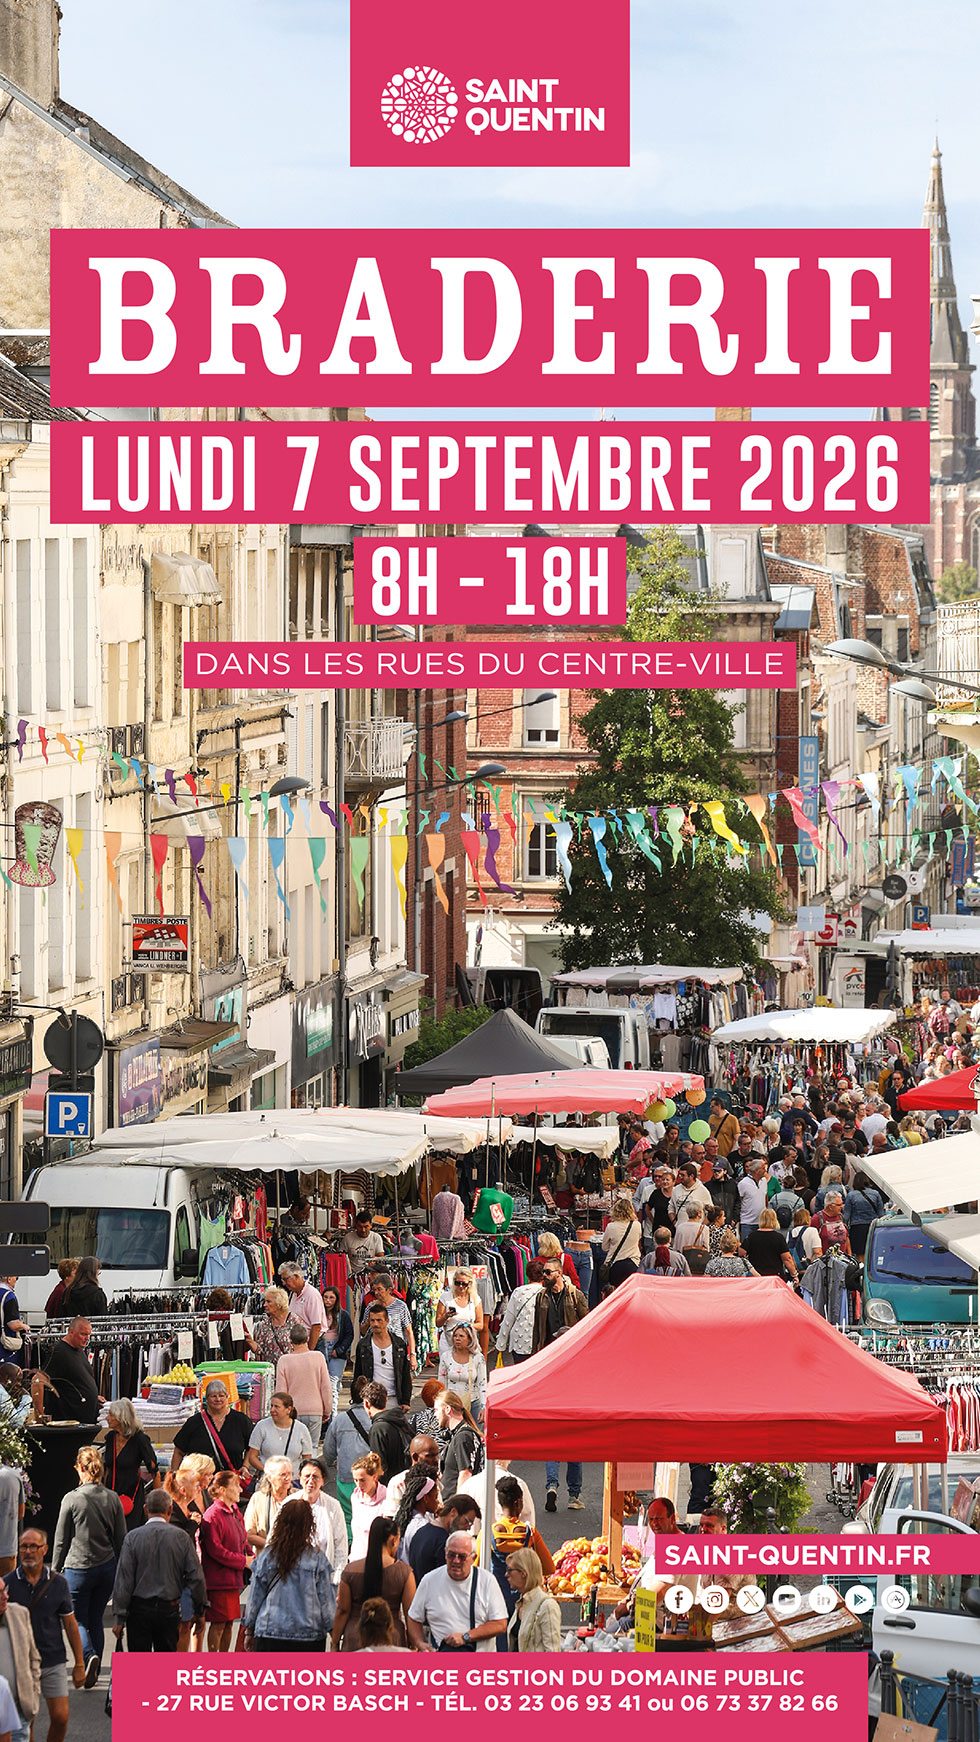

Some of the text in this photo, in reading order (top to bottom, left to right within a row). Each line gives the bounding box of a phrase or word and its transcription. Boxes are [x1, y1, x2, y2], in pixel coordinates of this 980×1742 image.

[802, 743, 815, 860] CSINES
[917, 909, 925, 920] P
[58, 1101, 79, 1129] P
